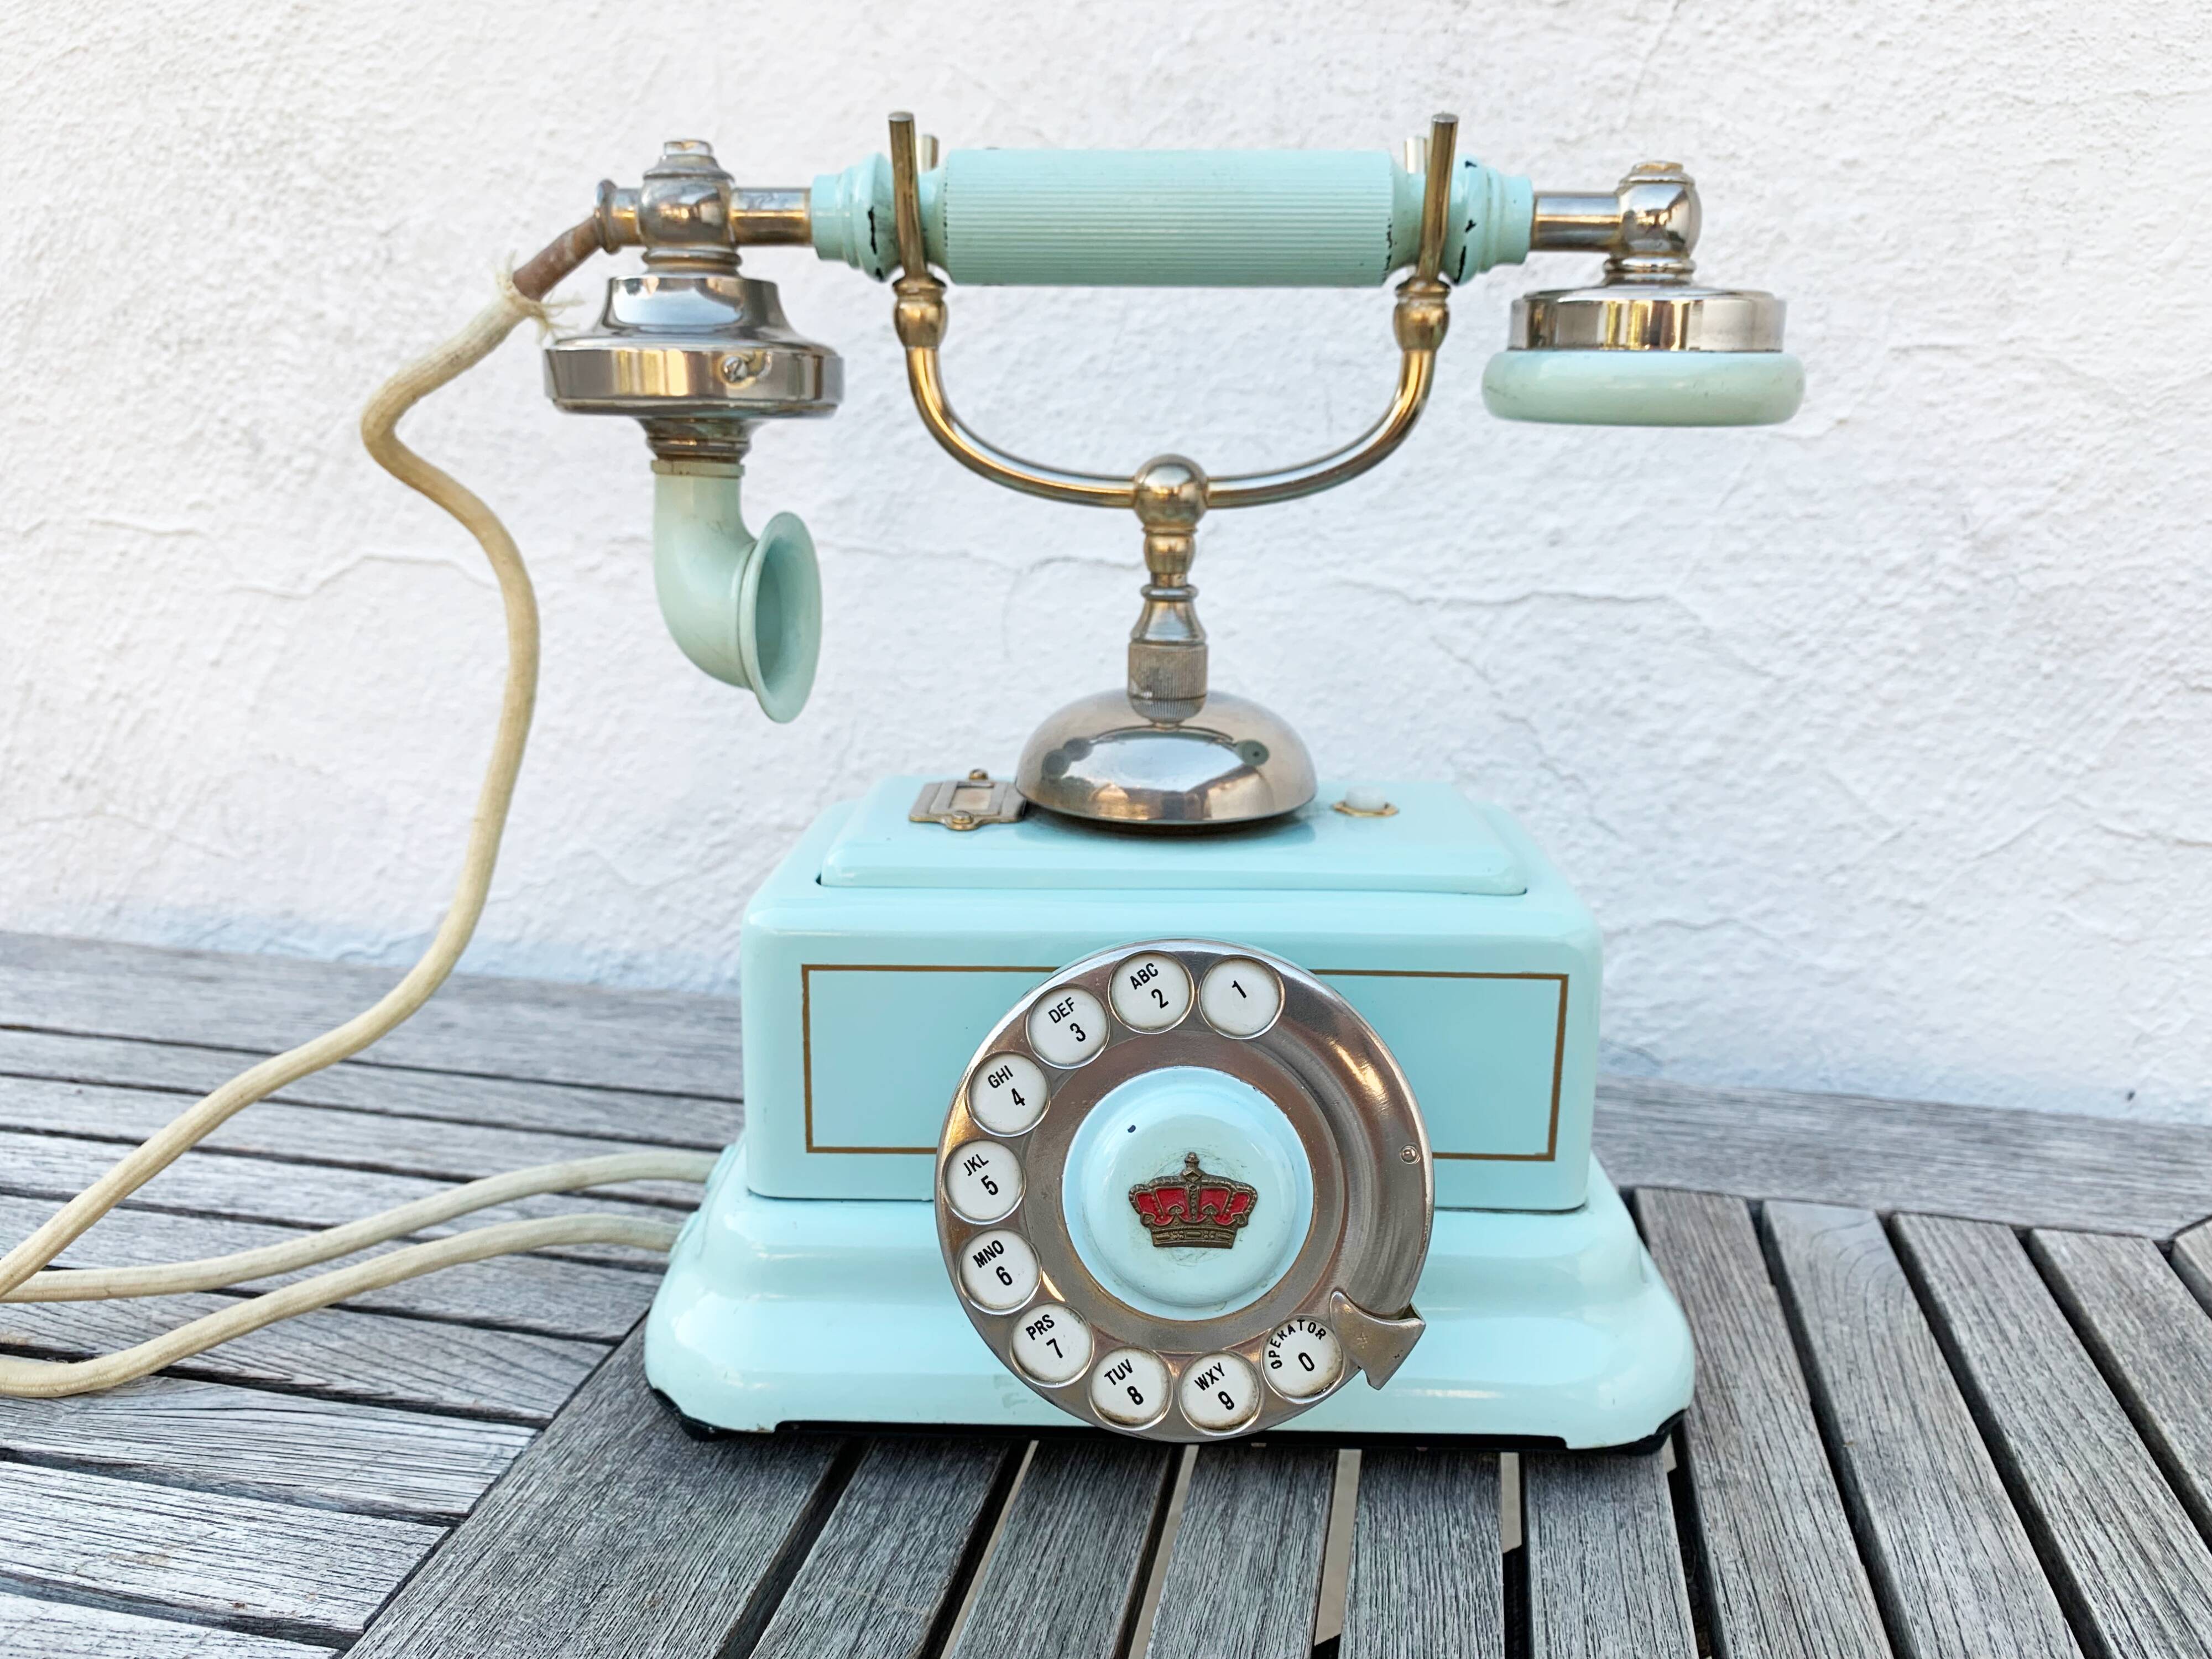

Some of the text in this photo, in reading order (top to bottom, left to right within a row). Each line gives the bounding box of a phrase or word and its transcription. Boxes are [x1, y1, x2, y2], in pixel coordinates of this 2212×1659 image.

[1129, 962, 1159, 990] ABC
[1151, 989, 1168, 1009] 2
[1232, 980, 1246, 998] 1
[1048, 997, 1076, 1024] DEF
[1070, 1023, 1086, 1042] 3
[988, 1065, 1014, 1089] GHI
[1011, 1088, 1025, 1105] 4
[963, 1154, 990, 1177] JKL
[981, 1175, 998, 1195] 5
[972, 1240, 1005, 1269] MNO
[996, 1266, 1012, 1286] 6
[1025, 1313, 1055, 1341] PRS
[1046, 1338, 1063, 1358] 7
[1298, 1353, 1314, 1371] 0
[1104, 1359, 1133, 1387] TUV
[1194, 1362, 1225, 1392] WXY
[1127, 1386, 1144, 1405] 8
[1218, 1391, 1234, 1410] 9
